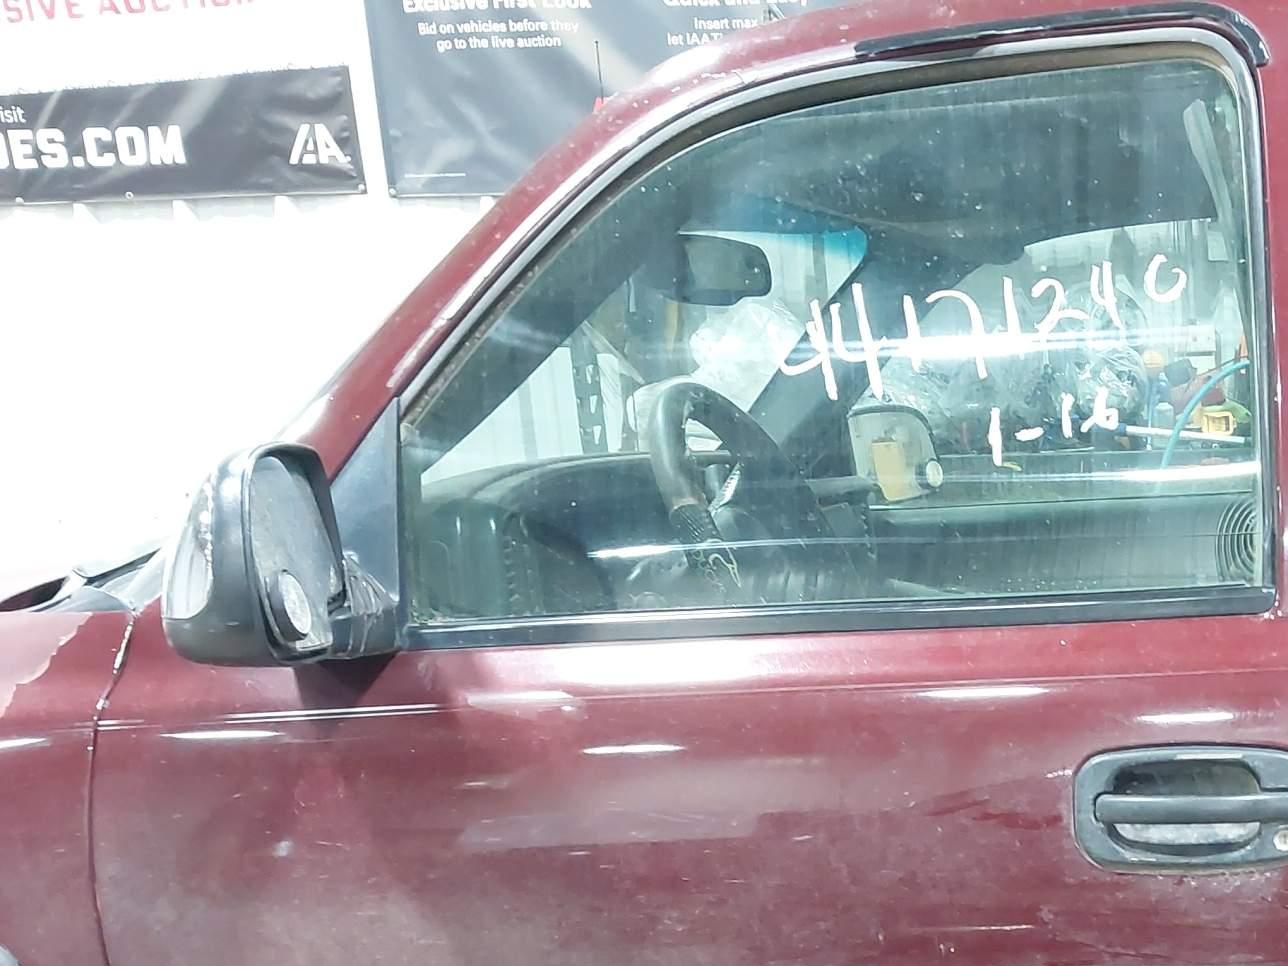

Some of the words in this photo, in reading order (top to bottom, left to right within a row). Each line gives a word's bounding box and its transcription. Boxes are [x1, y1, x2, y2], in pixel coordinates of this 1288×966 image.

[417, 22, 437, 35] Bid
[439, 23, 455, 34] on
[456, 20, 507, 33] vehicles
[508, 19, 548, 32] before
[550, 19, 579, 33] they
[694, 17, 730, 30] Insert
[436, 39, 452, 52] go
[454, 38, 467, 49] to
[468, 36, 489, 48] the
[491, 35, 515, 47] live
[517, 34, 562, 47] auction
[667, 32, 684, 45] let
